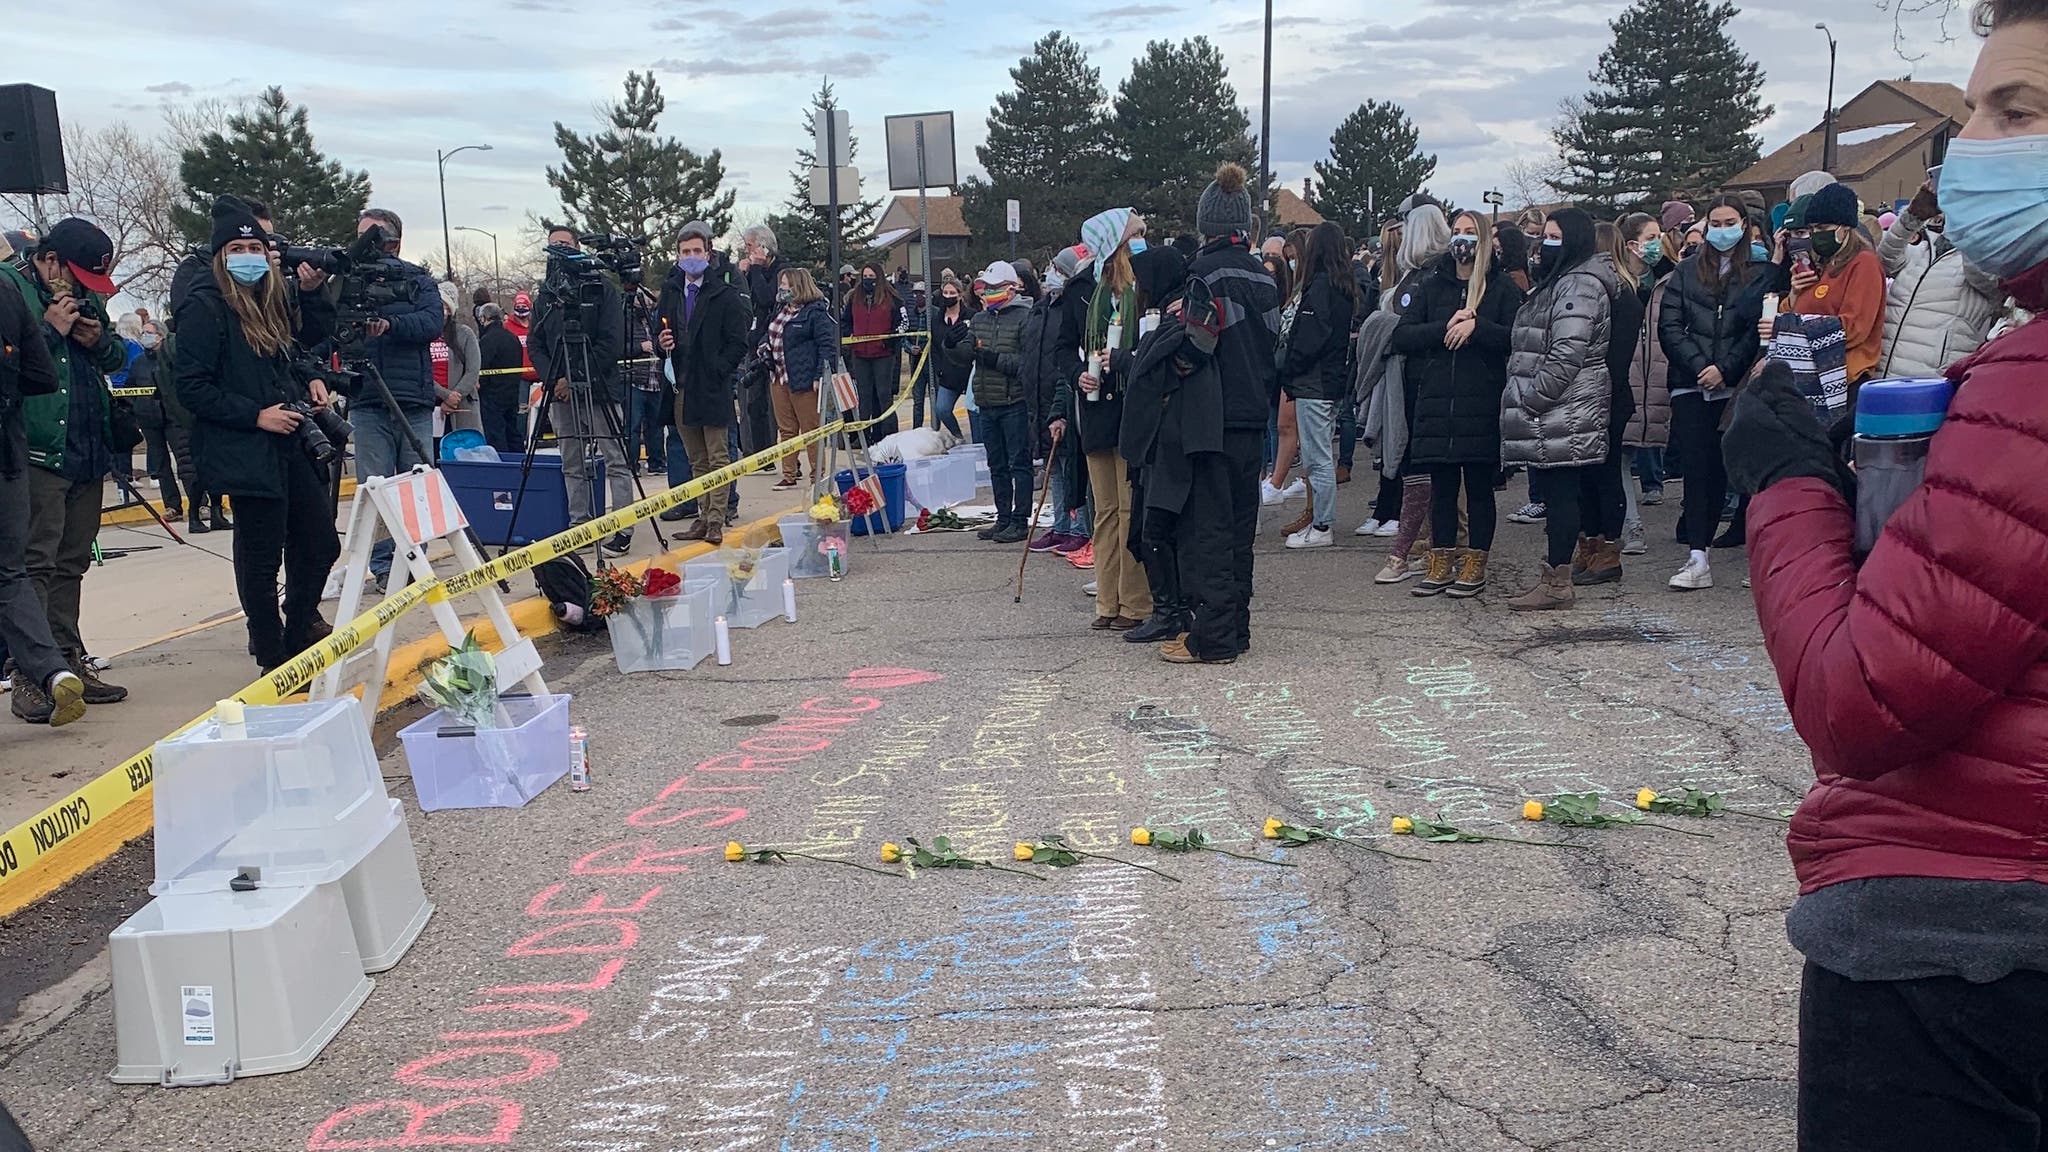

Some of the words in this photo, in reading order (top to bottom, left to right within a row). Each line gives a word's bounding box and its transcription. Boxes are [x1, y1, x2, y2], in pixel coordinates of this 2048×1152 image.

[503, 550, 533, 573] CAUTION
[313, 648, 325, 671] DO
[328, 626, 360, 660] CAUTION
[271, 663, 300, 697] ENTER
[298, 654, 315, 682] NOT
[29, 796, 91, 856] CAUTION
[308, 841, 724, 1147] BOULDER
[627, 696, 881, 827] STRONG
